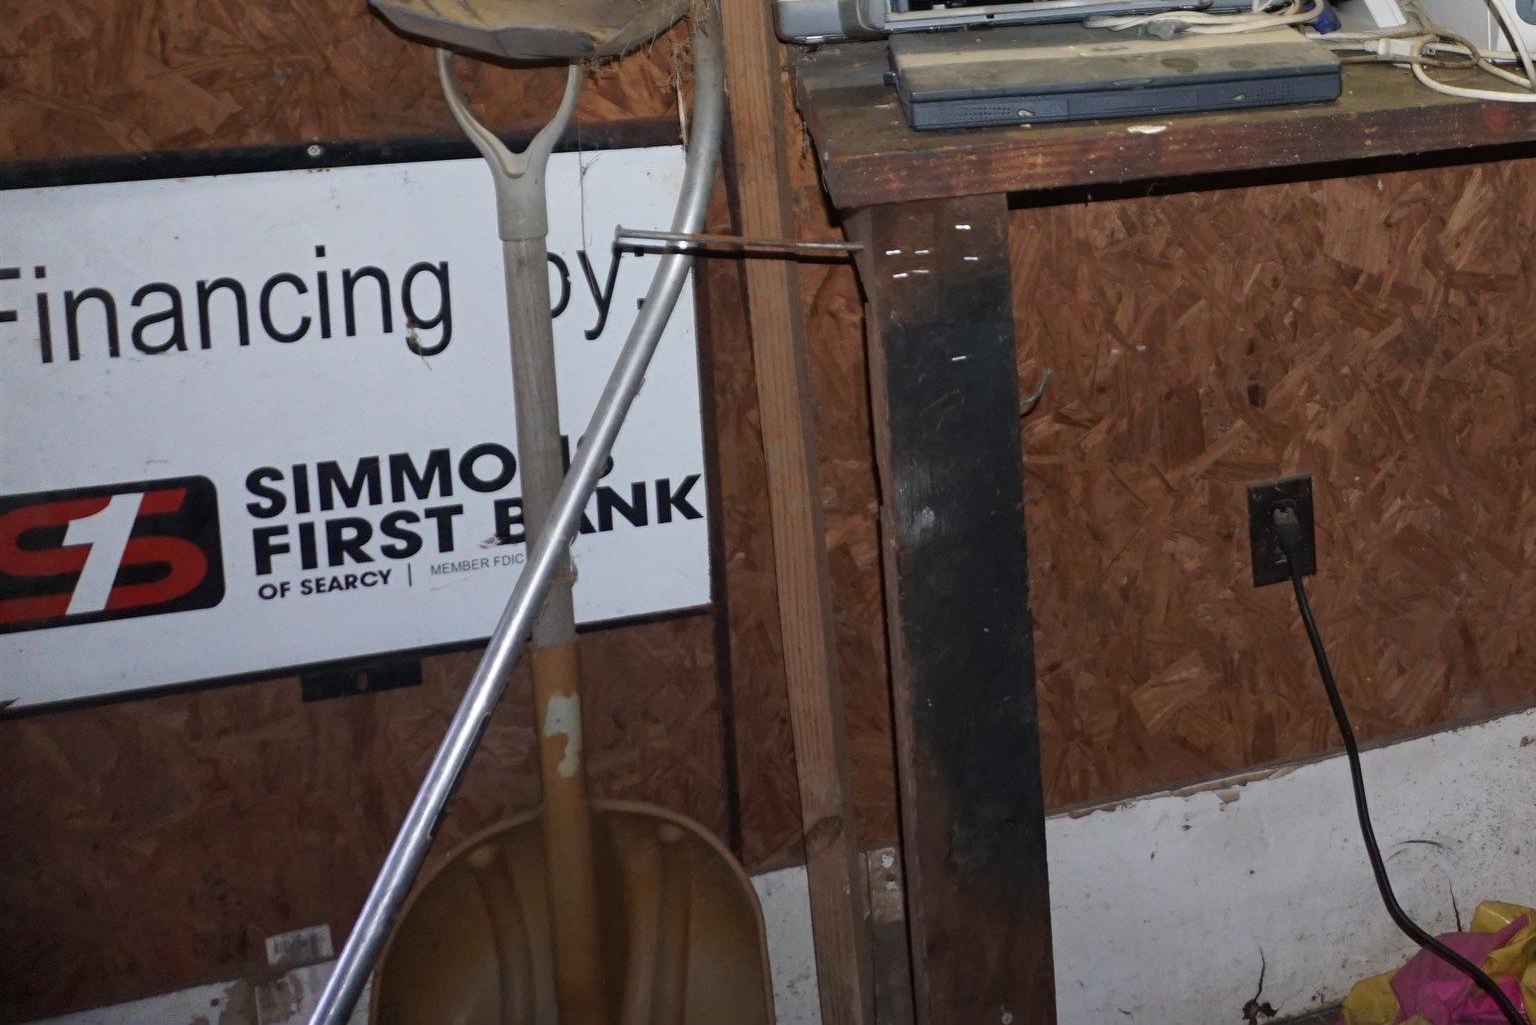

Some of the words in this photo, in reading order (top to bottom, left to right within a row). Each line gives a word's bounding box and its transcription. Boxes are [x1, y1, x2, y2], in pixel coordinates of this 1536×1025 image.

[245, 435, 613, 518] SIMMO
[253, 504, 464, 576] FIRST
[494, 474, 704, 545] BNK
[258, 581, 291, 600] OF
[300, 568, 392, 595] SEARCY
[430, 557, 490, 575] MEMBER
[494, 553, 525, 567] FDIC
